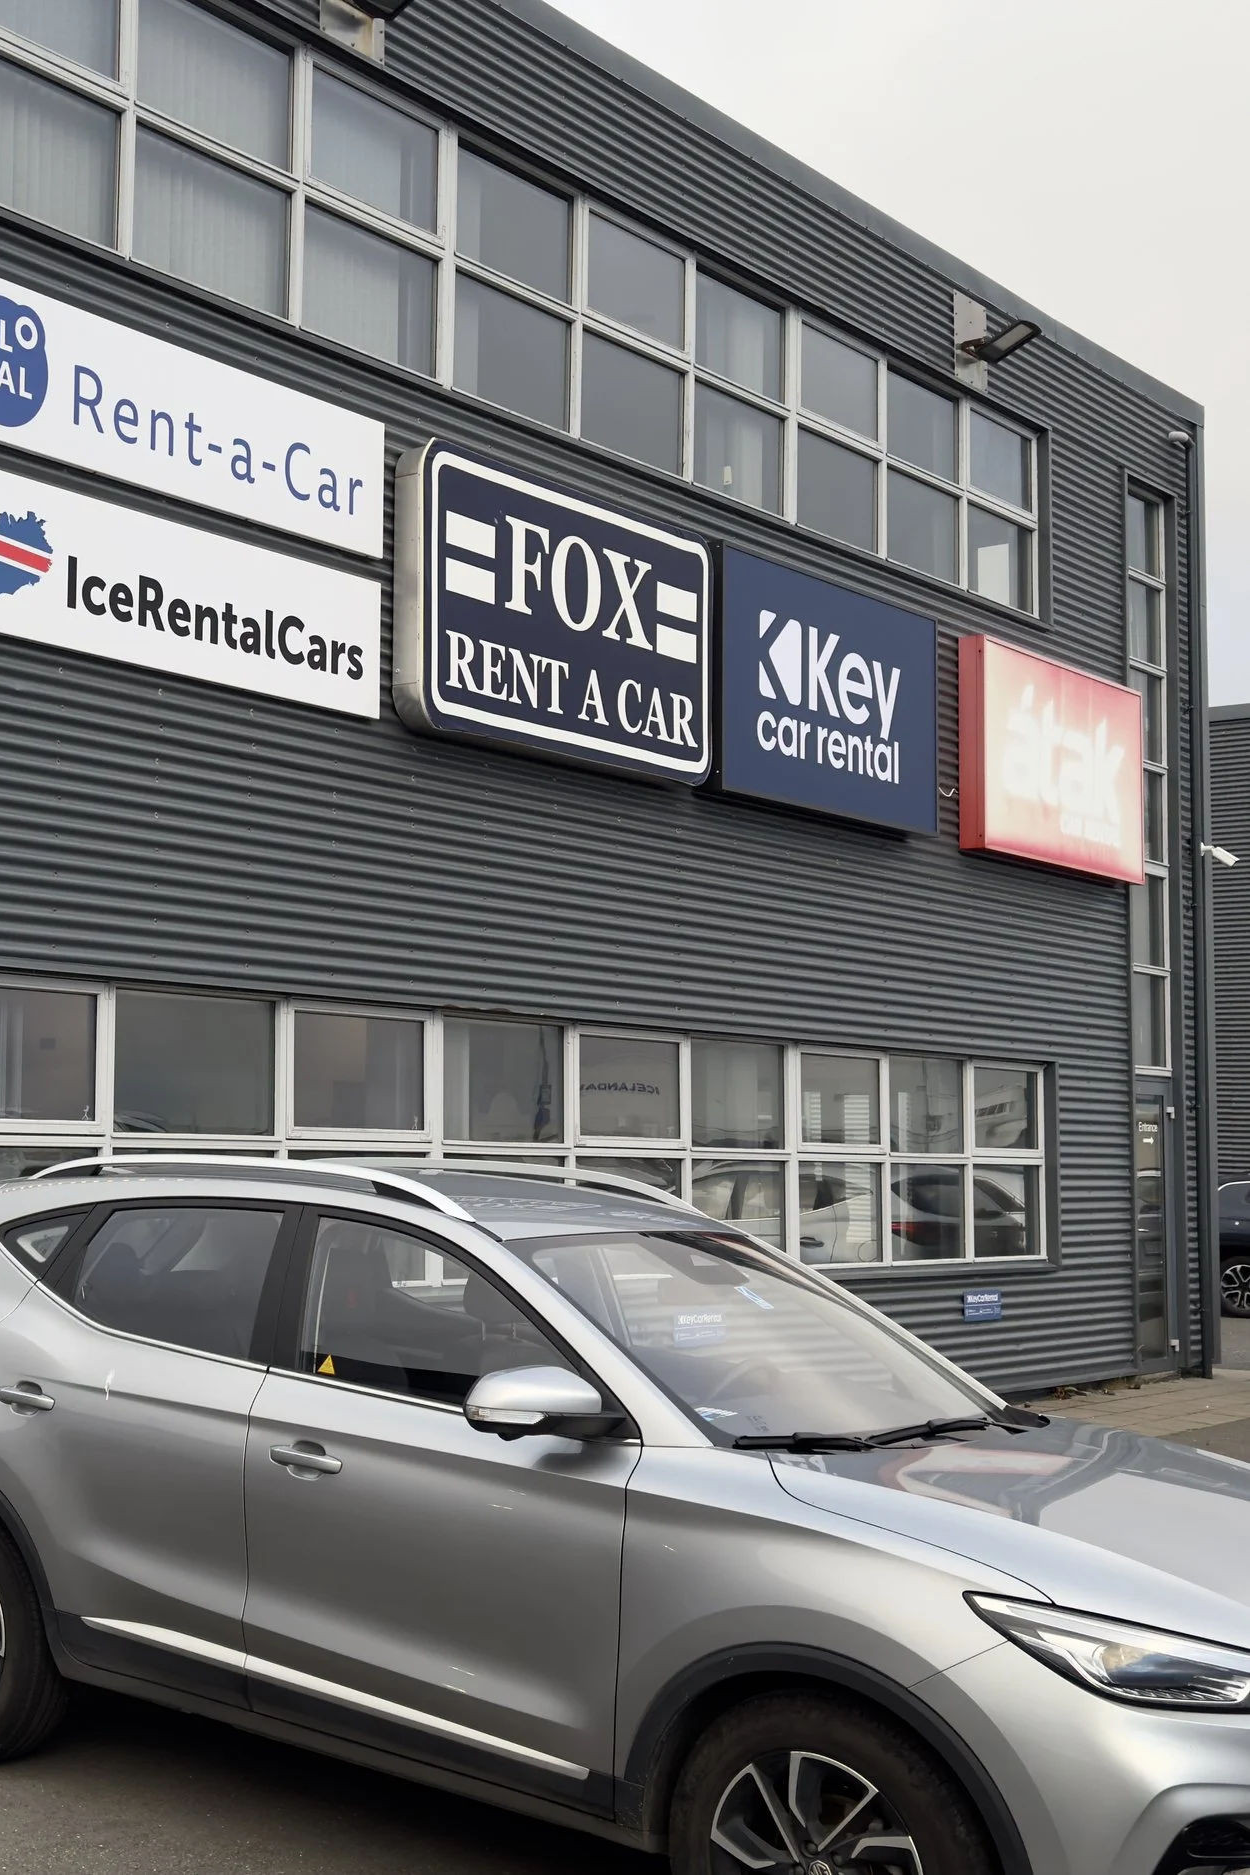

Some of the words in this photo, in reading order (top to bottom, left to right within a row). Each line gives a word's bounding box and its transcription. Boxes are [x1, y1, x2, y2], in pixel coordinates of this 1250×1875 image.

[73, 365, 363, 516] Rent-a-Car
[66, 555, 364, 681] IceRentalCars
[504, 514, 654, 651] FOX
[445, 629, 569, 715] RENT
[578, 669, 610, 726] A
[617, 679, 699, 748] CAR
[808, 625, 901, 742] Key
[756, 710, 811, 760] car
[817, 725, 900, 785] rental
[1138, 1121, 1158, 1132] Entrance
